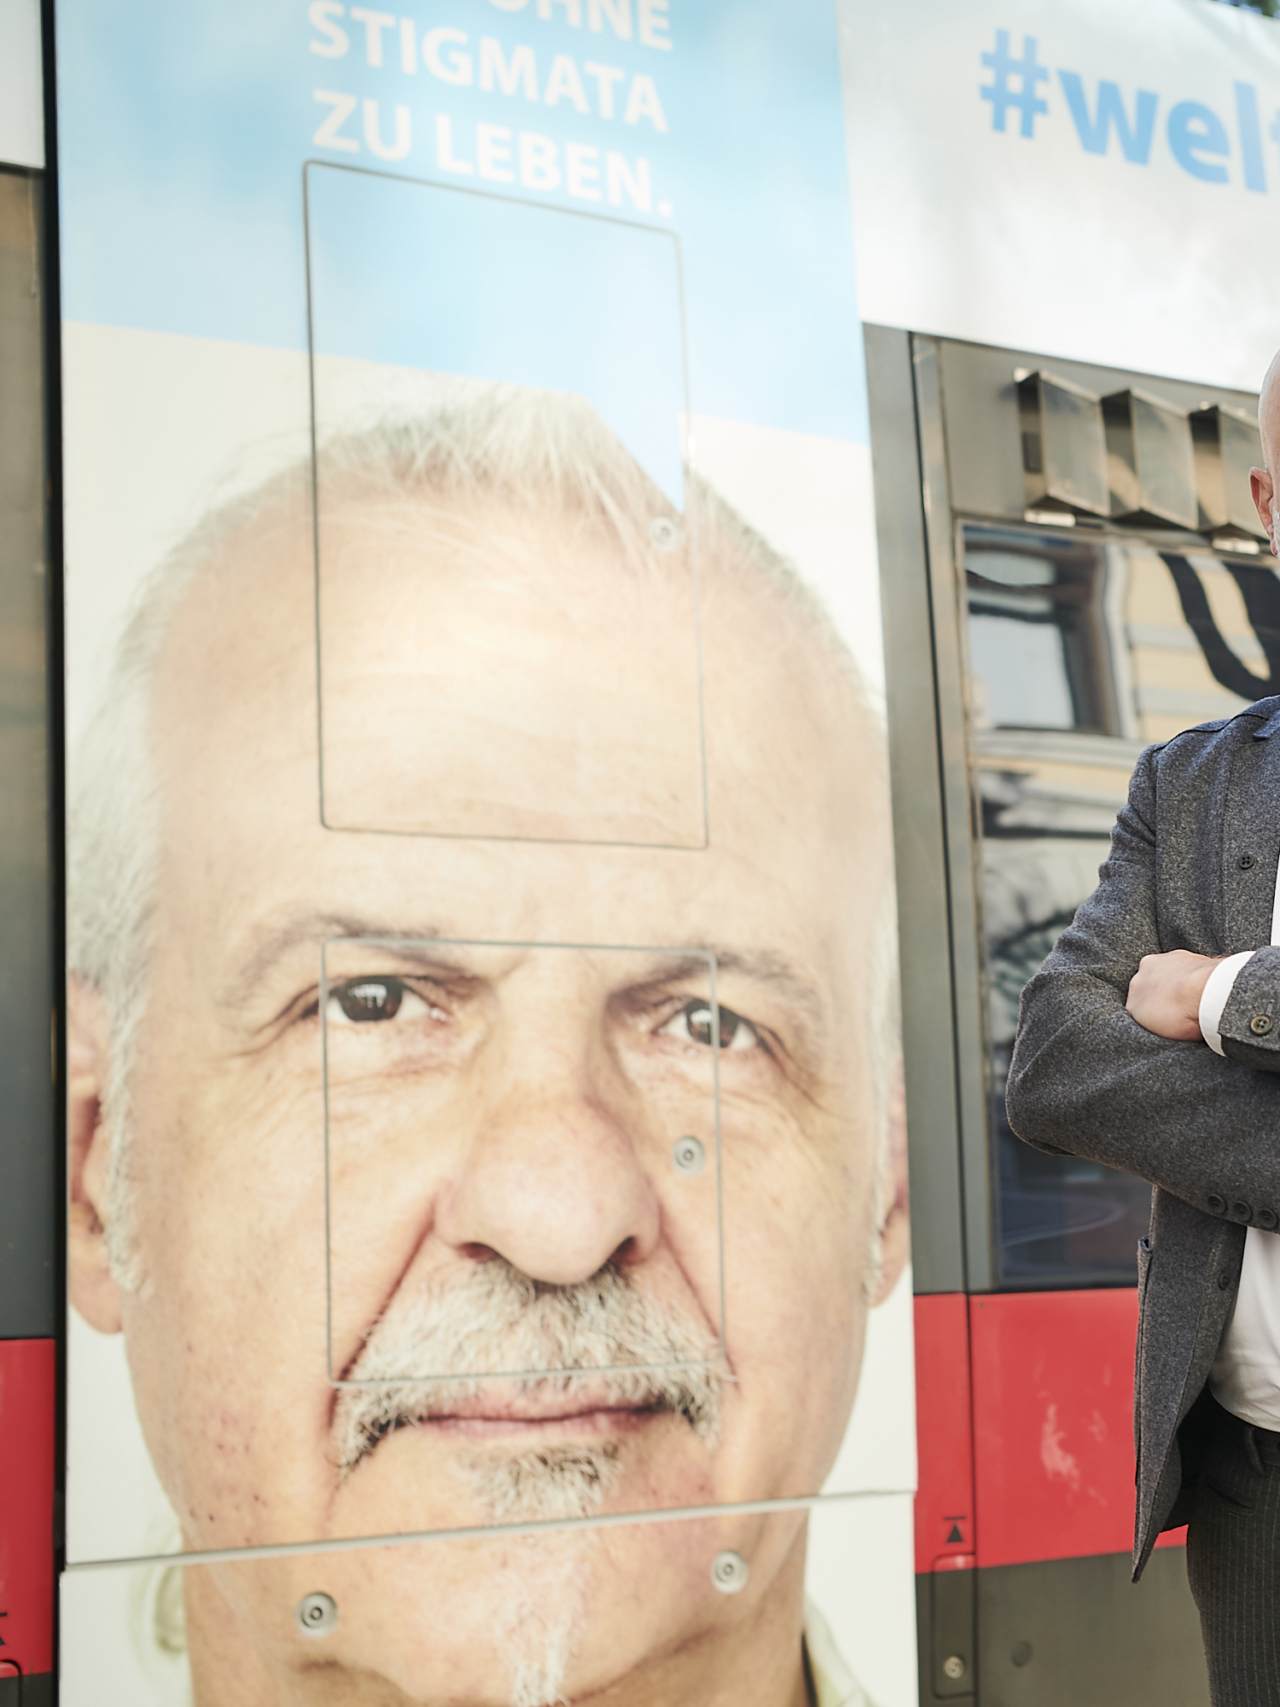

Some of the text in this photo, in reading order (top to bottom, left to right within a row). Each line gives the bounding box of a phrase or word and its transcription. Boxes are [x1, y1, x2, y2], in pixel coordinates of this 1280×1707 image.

[308, 1, 669, 133] STIGMATA
[490, 0, 674, 52] NE
[312, 88, 674, 218] ZU LEBEN.
